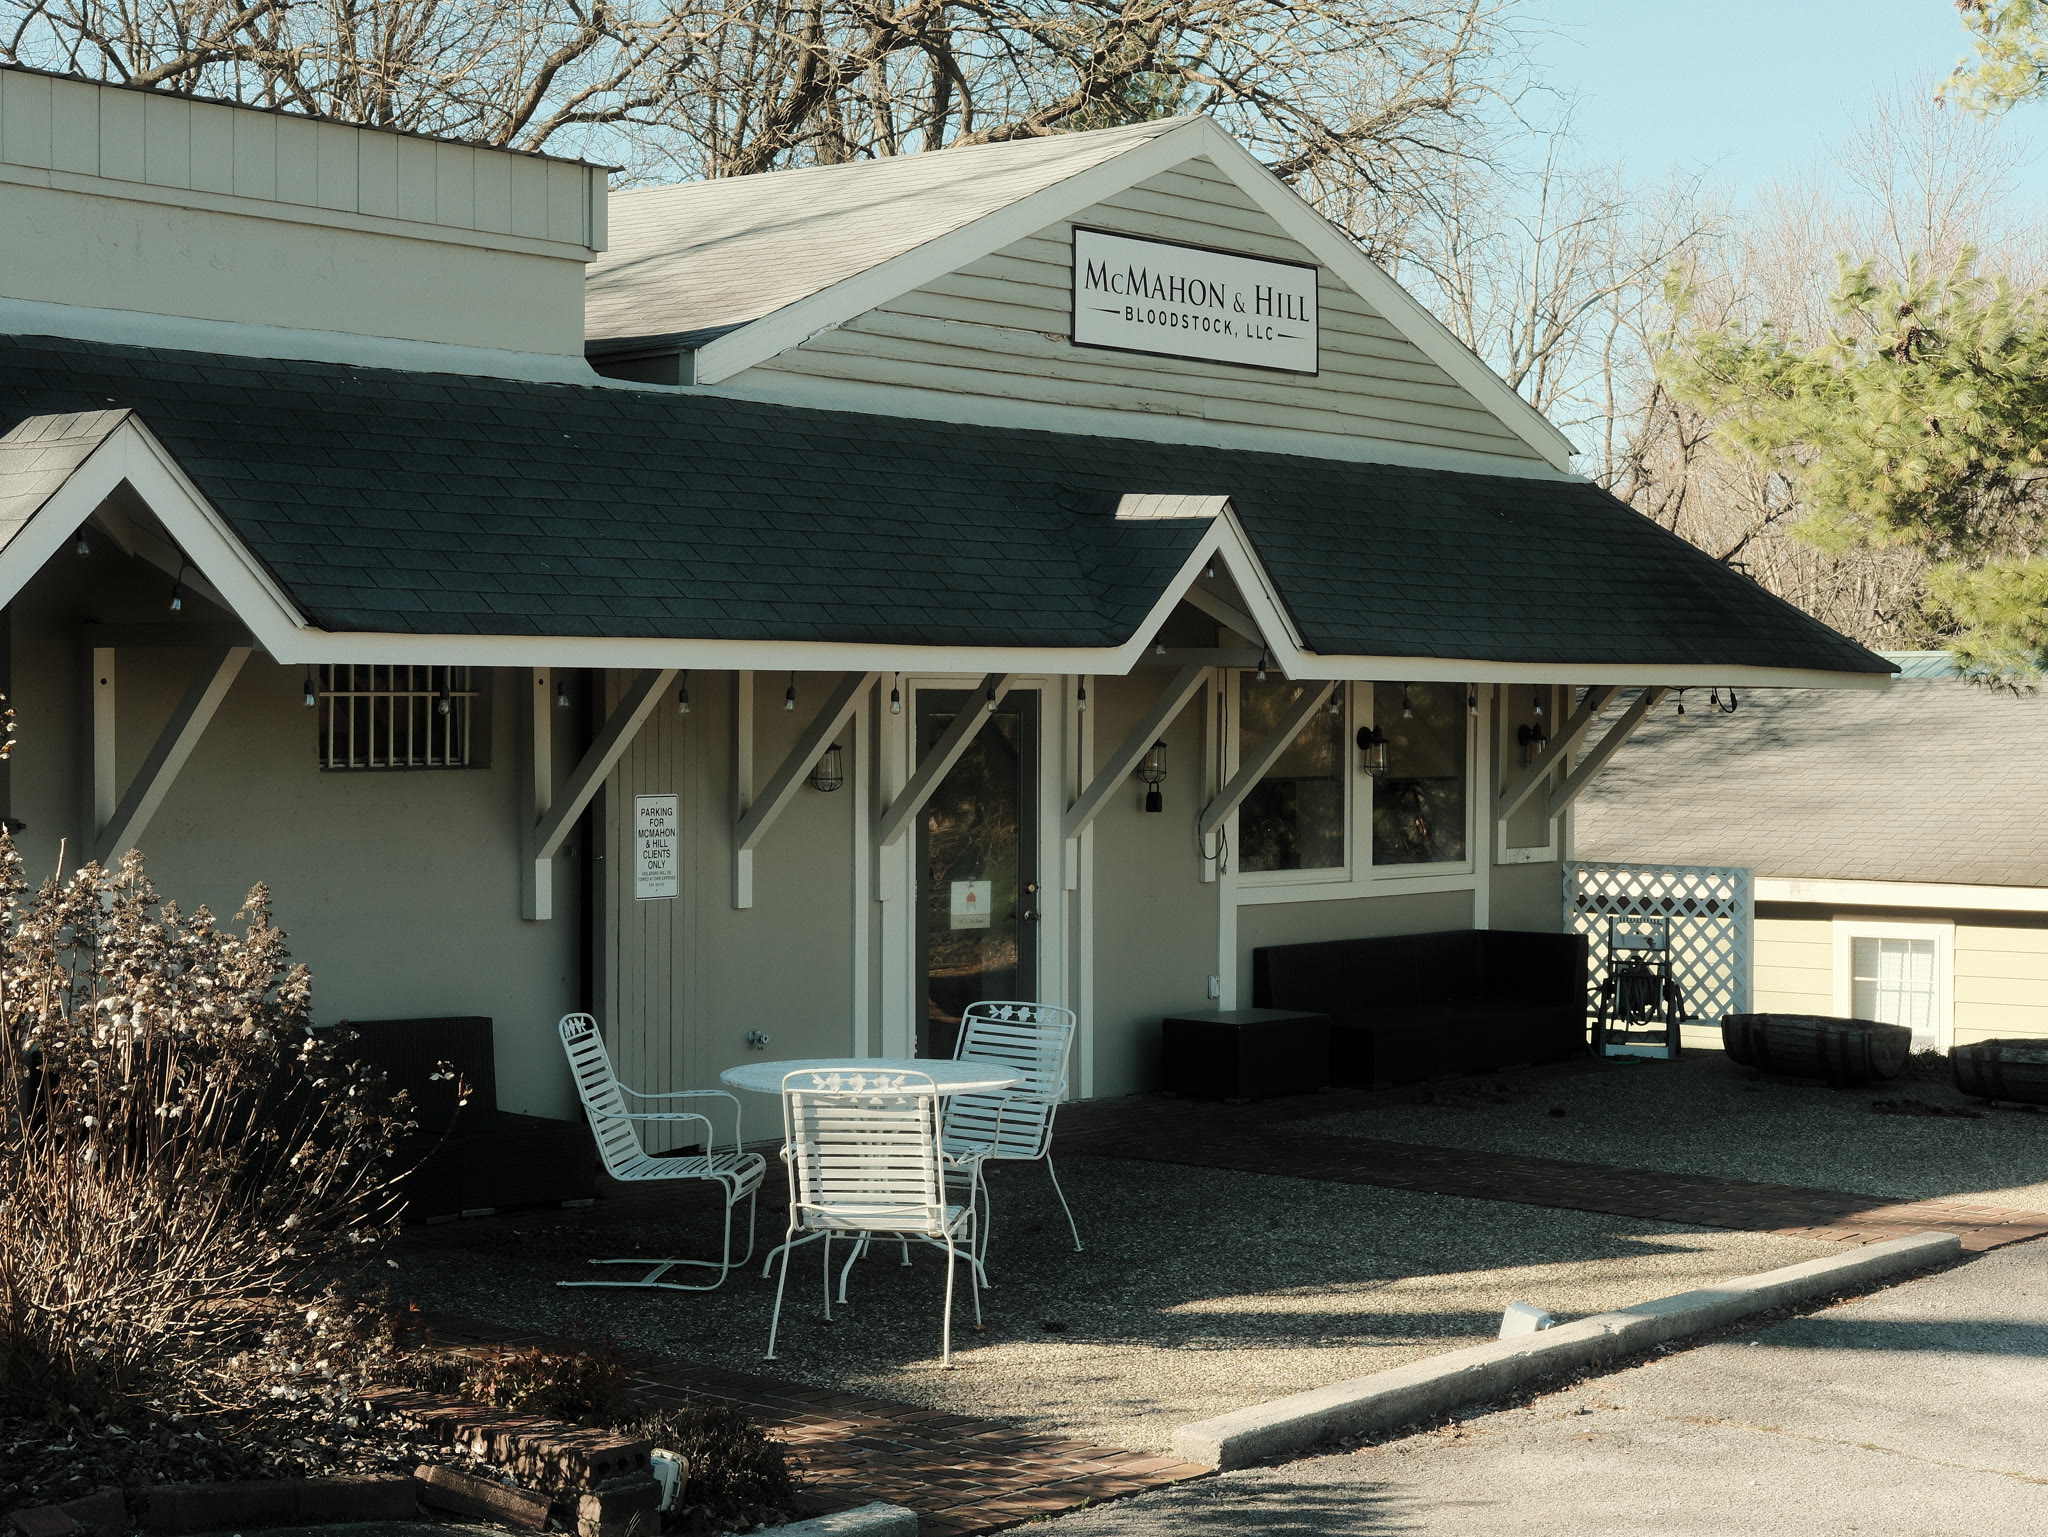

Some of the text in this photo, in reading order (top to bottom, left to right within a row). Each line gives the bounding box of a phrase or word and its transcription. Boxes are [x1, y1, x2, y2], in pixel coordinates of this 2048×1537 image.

[1233, 291, 1246, 314] &
[1254, 284, 1310, 323] HILL
[1125, 306, 1274, 341] BLOODSTOCK, LLC
[640, 807, 673, 817] PARKING
[649, 818, 665, 827] FOR
[638, 828, 676, 838] MCMAHON
[645, 839, 668, 849] & HILL
[642, 849, 671, 859] CLIENTS
[647, 860, 666, 869] ONLY
